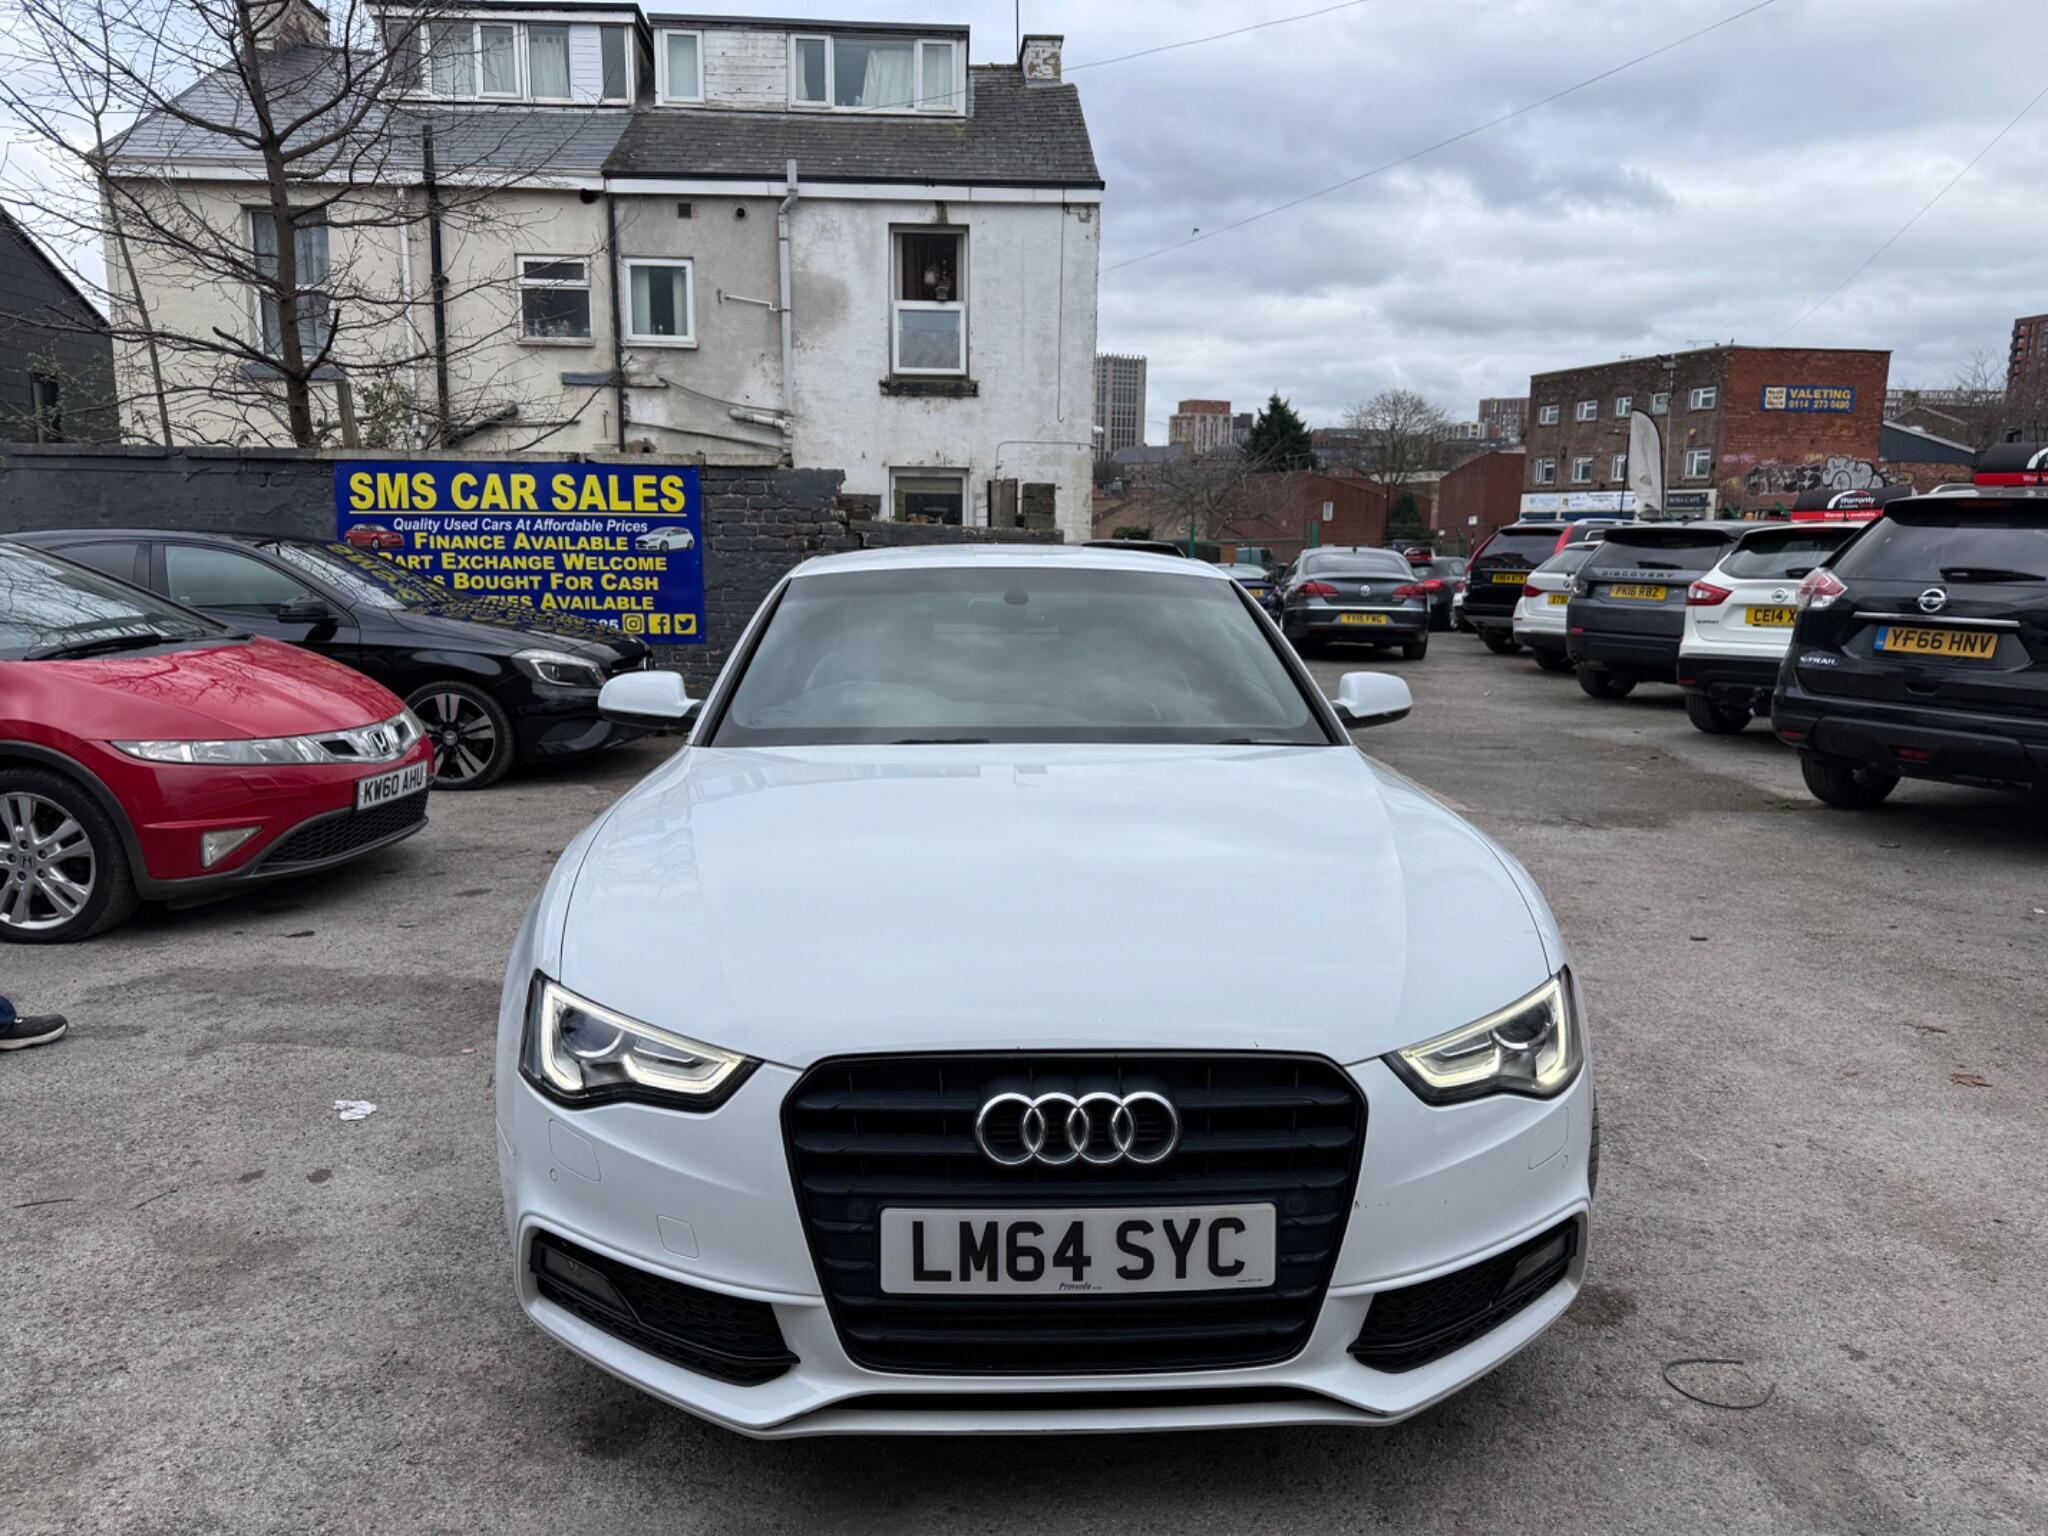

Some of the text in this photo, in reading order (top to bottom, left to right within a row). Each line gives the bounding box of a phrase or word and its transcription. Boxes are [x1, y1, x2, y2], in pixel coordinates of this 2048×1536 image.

[1789, 388, 1851, 399] VALETING
[1789, 400, 1809, 409] 0114
[1814, 400, 1828, 409] 273
[349, 471, 686, 513] SMS CAR SALES
[393, 517, 648, 534] Quality Used Cars At Affordable Prices
[414, 532, 629, 551] FINANCE AVAILABLE
[441, 552, 556, 570] EXCHANGE
[562, 553, 668, 571] WELCOME
[453, 572, 543, 591] BOUGHT
[550, 573, 594, 591] FOR
[601, 573, 659, 591] CASH
[1602, 570, 1675, 578] DISCOVERY
[540, 592, 655, 611] AVAILABLE
[1753, 608, 1784, 622] CE14
[1891, 629, 1993, 653] YF66 HNV
[364, 765, 425, 804] KW60 AHU
[912, 1216, 1247, 1283] LM64 SYC
